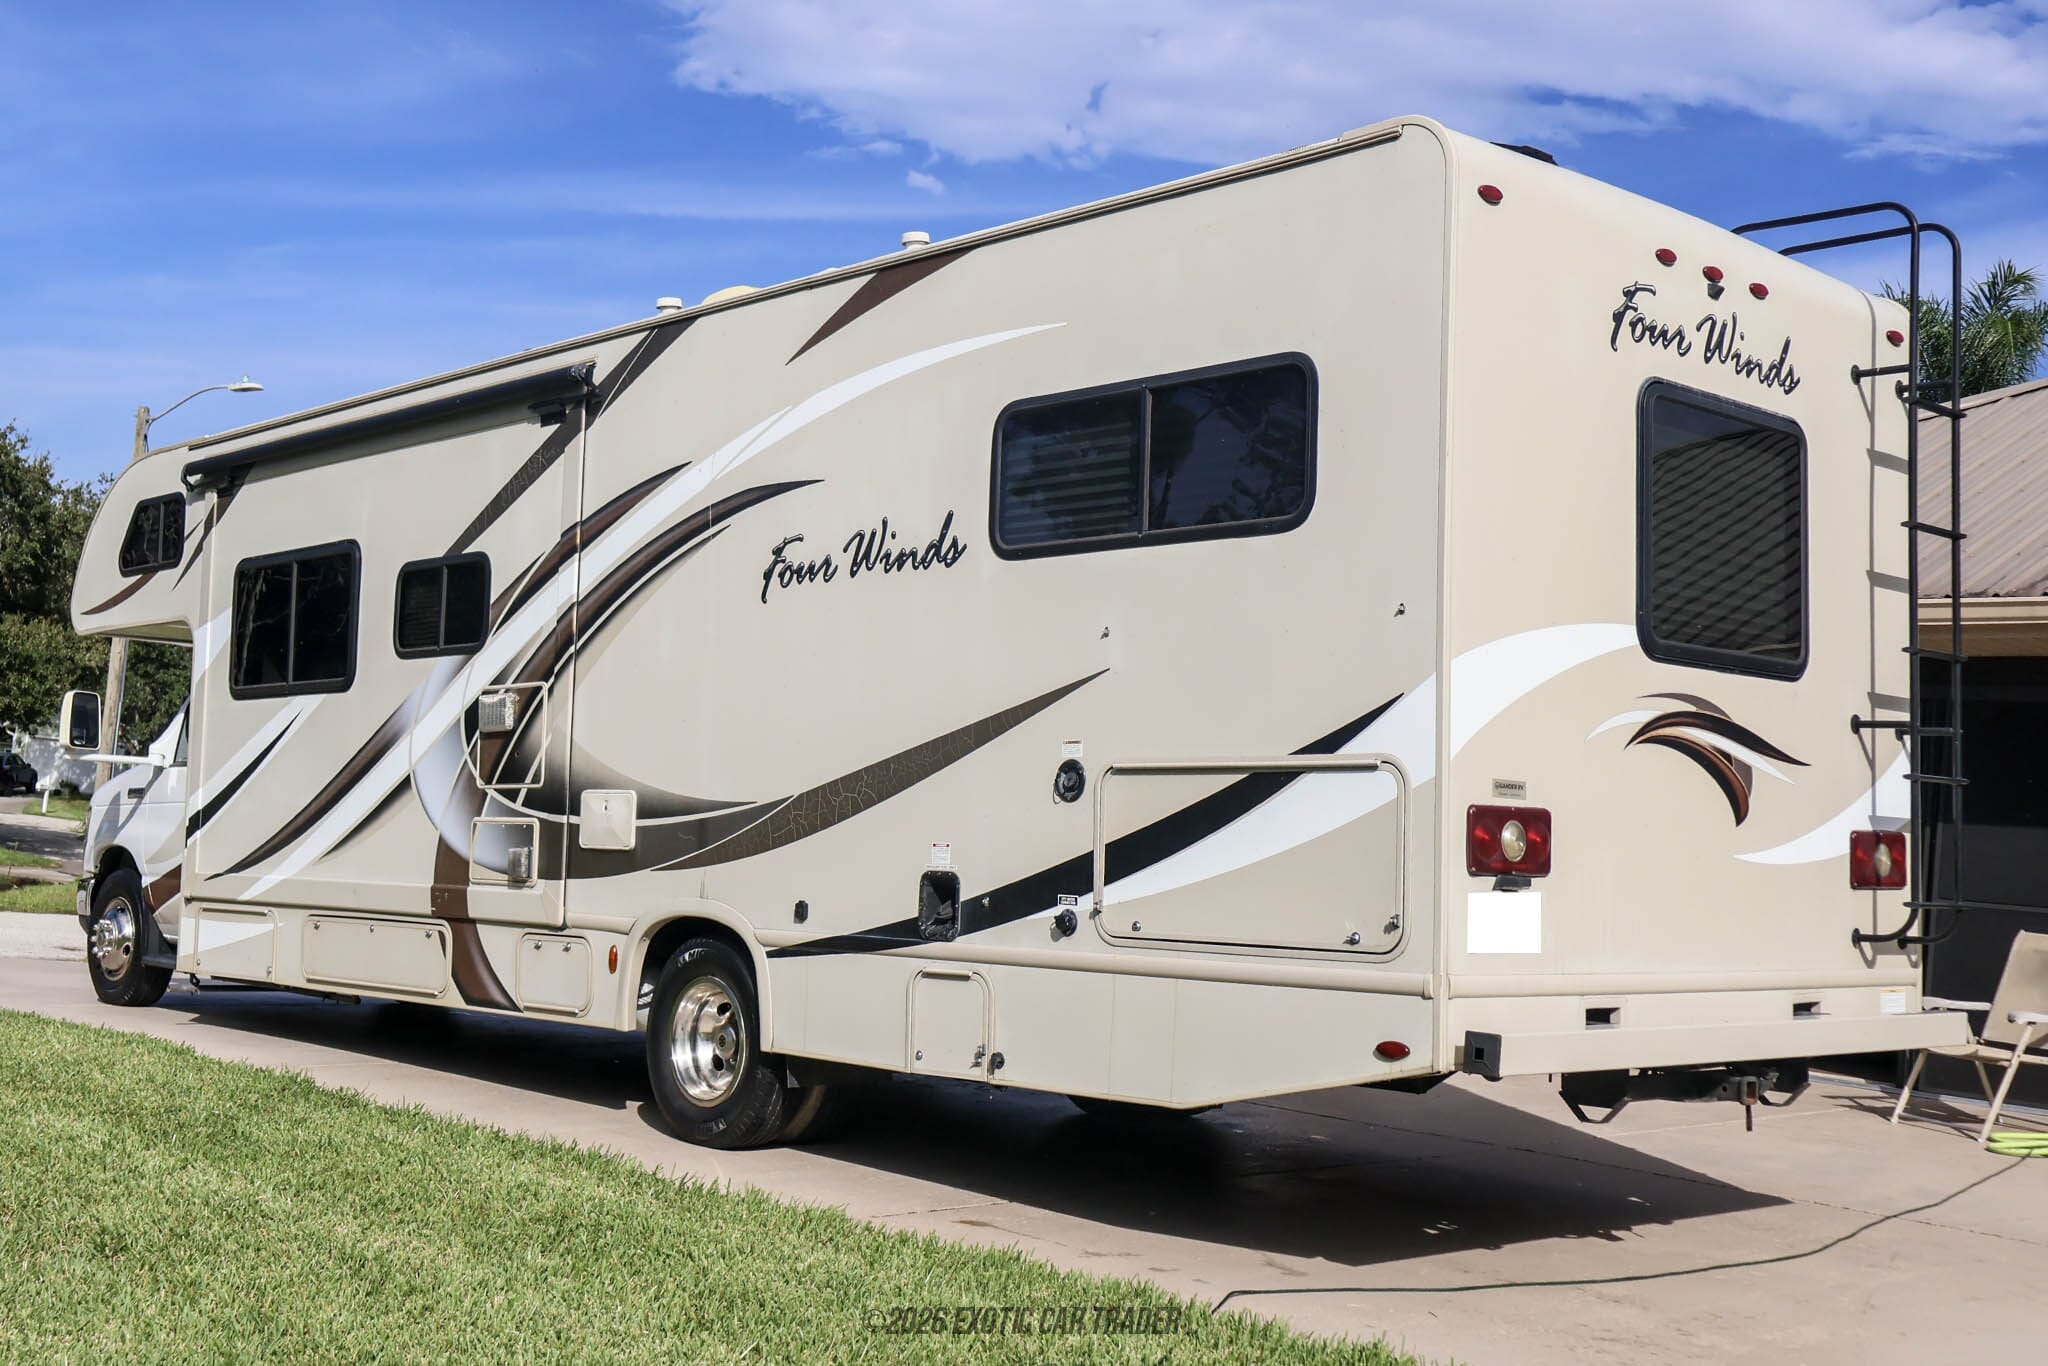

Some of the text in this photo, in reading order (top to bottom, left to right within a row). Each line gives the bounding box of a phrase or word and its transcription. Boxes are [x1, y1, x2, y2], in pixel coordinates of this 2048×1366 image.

[1610, 281, 1801, 395] Four Winds
[761, 509, 967, 604] Four Winds
